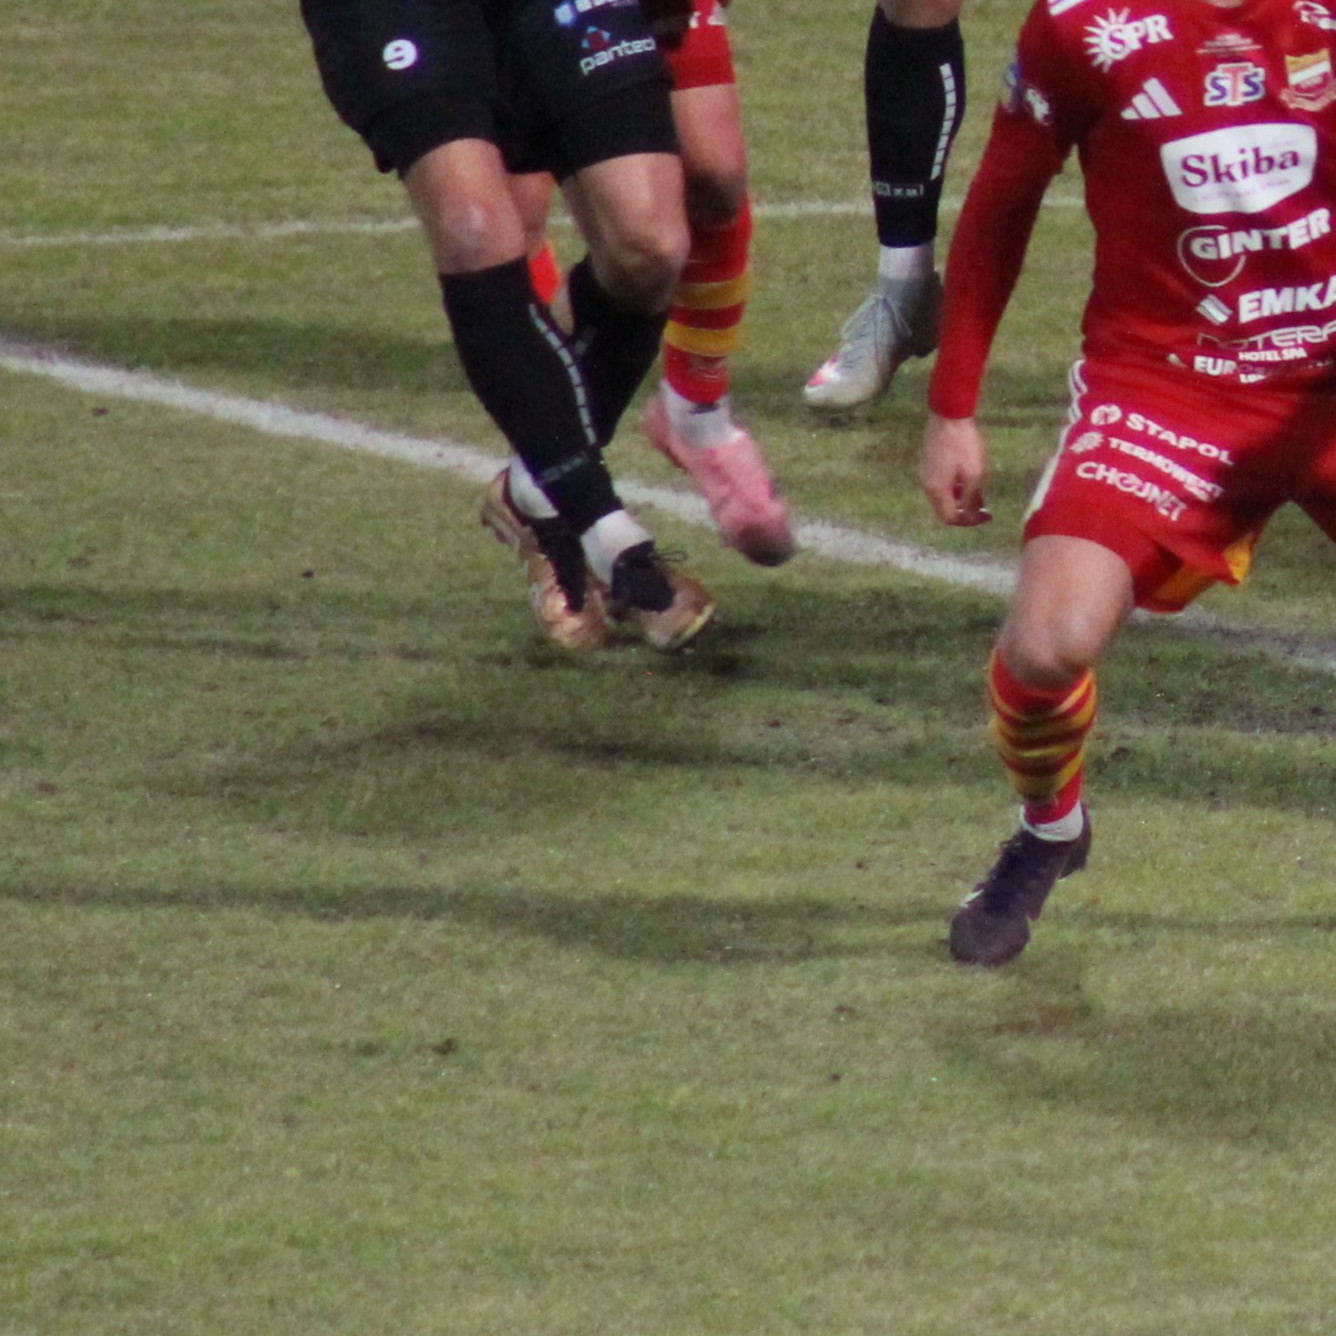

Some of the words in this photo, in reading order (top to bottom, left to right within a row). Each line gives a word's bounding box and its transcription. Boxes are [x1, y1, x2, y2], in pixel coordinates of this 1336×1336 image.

[1105, 15, 1173, 56] SPR
[1204, 62, 1265, 107] STS
[1181, 145, 1299, 187] Skiba
[1190, 208, 1331, 259] GINTER
[1239, 349, 1280, 361] HOTEL
[1283, 348, 1307, 359] SPA
[1126, 413, 1234, 466] STAPOL
